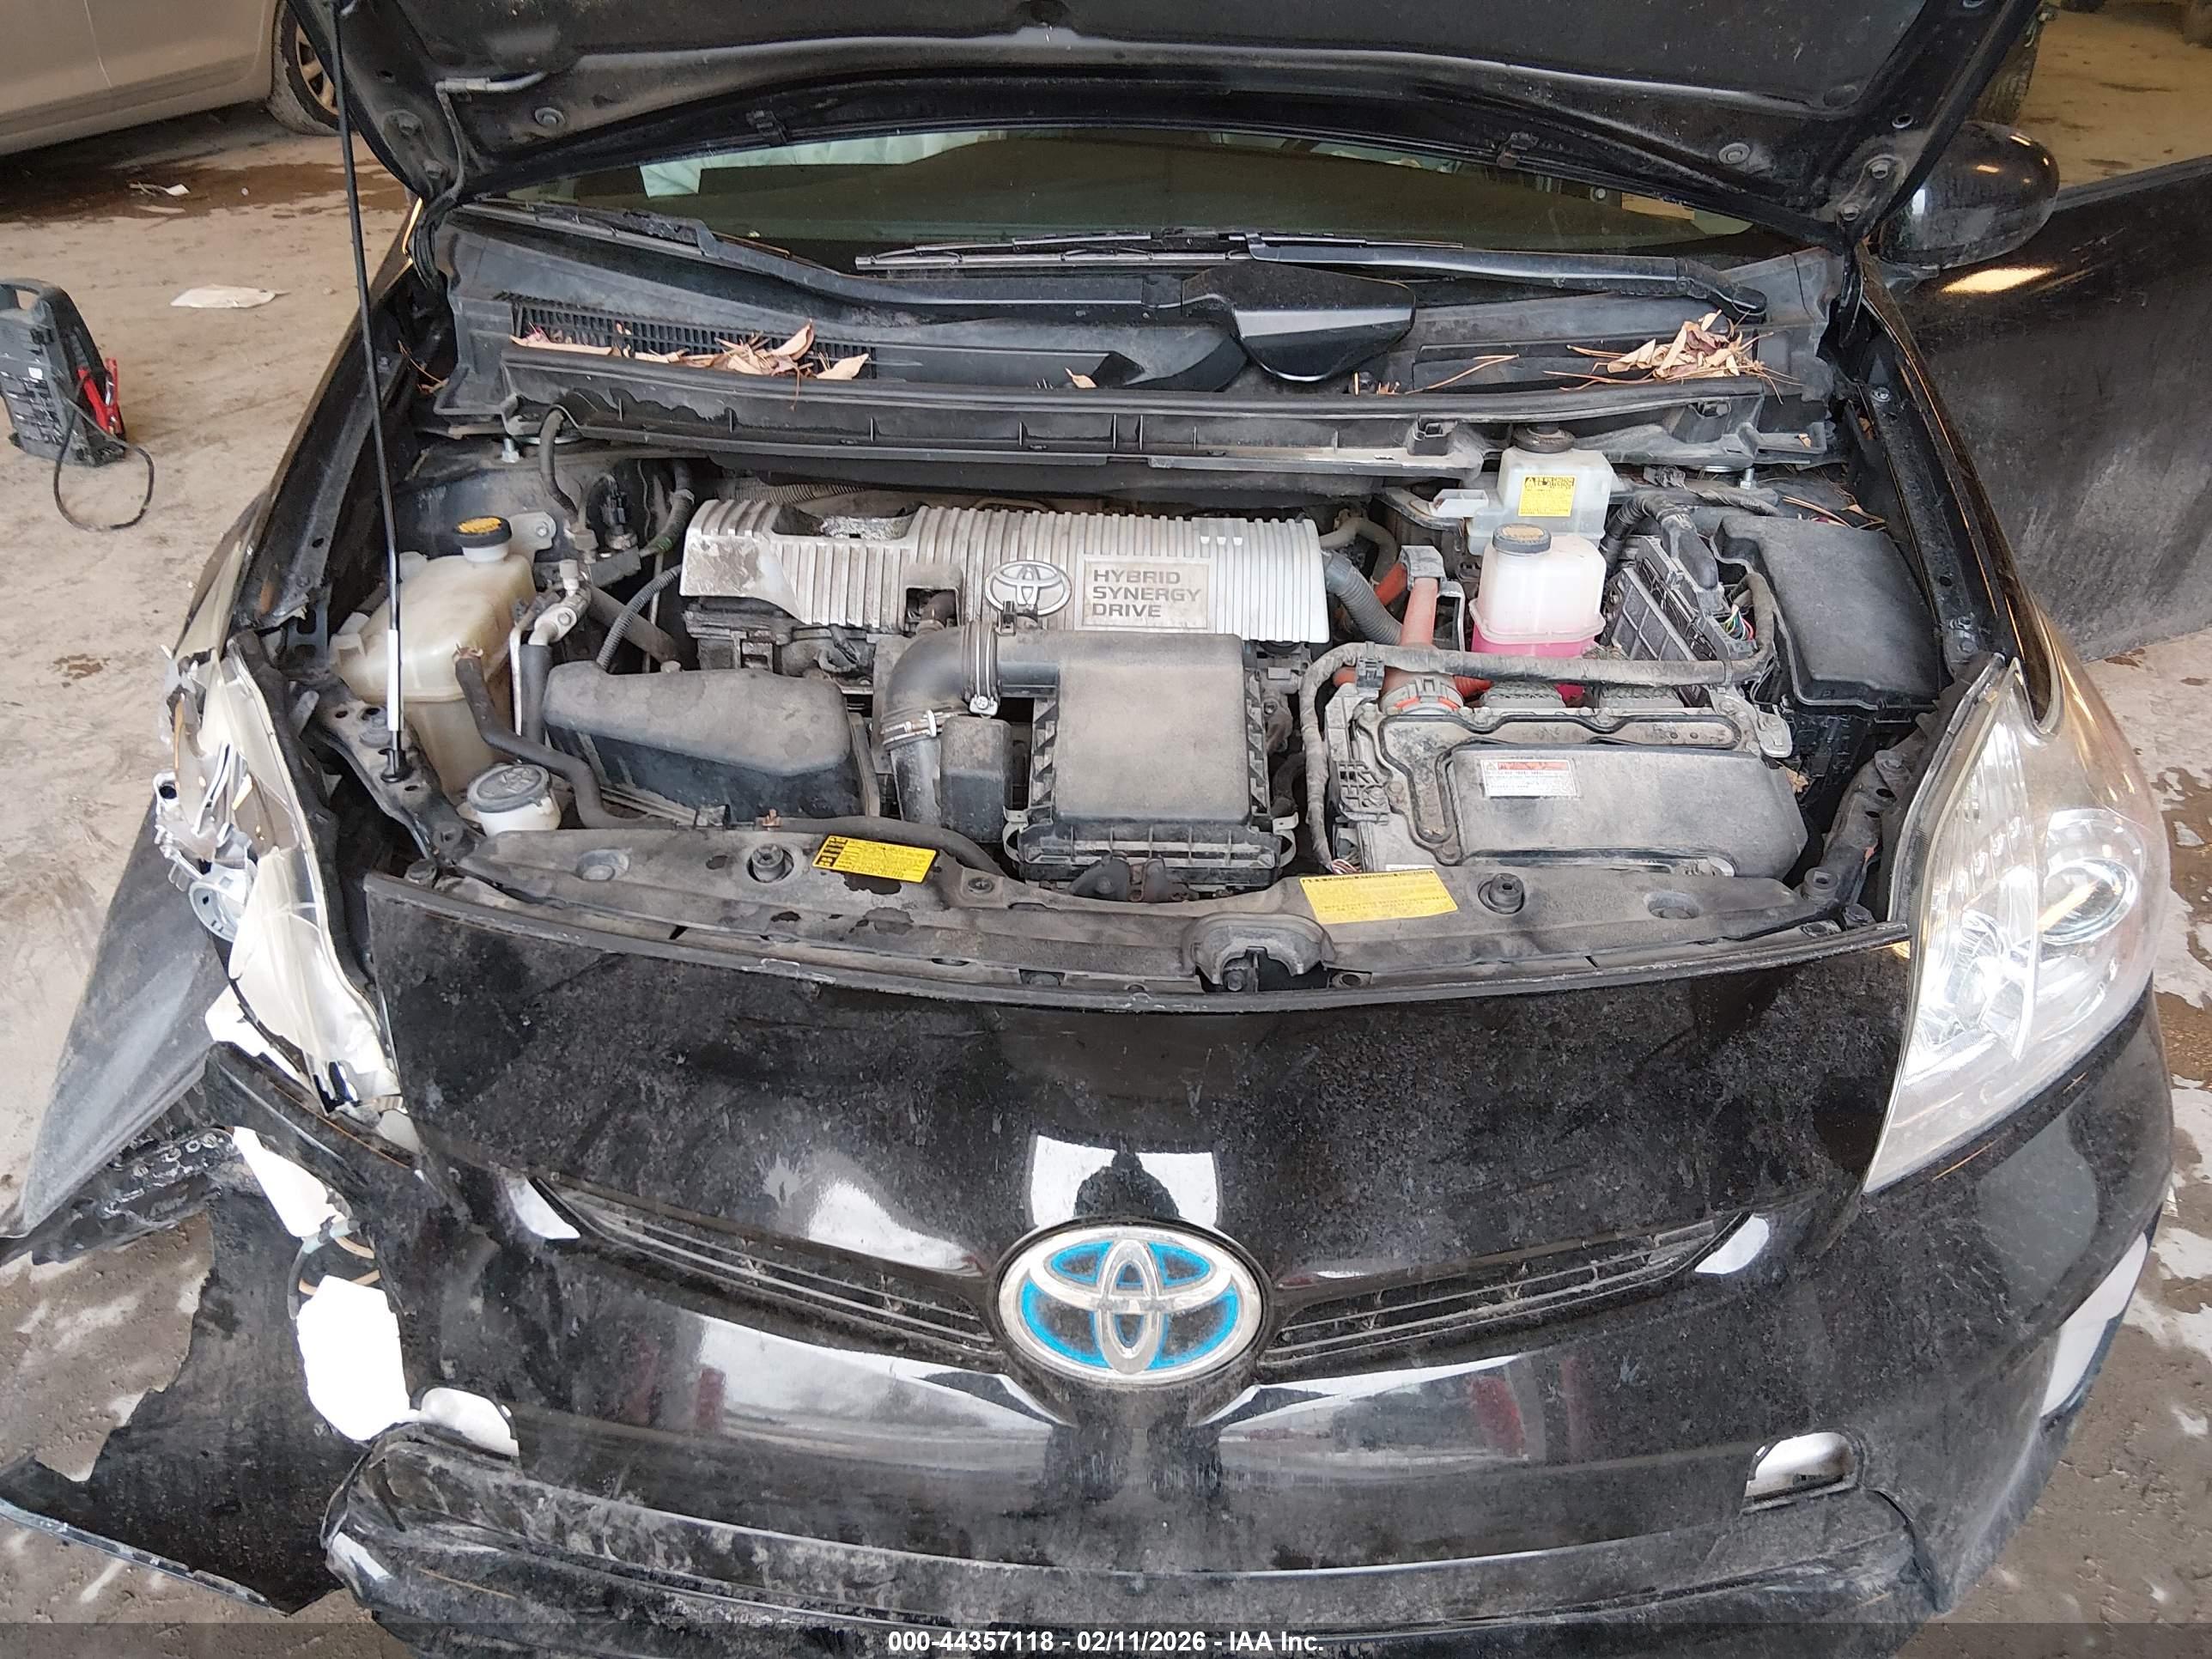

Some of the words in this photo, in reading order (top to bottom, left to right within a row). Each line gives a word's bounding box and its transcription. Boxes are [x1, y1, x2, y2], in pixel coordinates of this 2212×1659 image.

[1093, 569, 1181, 585] HYBRID
[1092, 586, 1201, 602] SYNERGY
[1091, 603, 1162, 617] DRIVE
